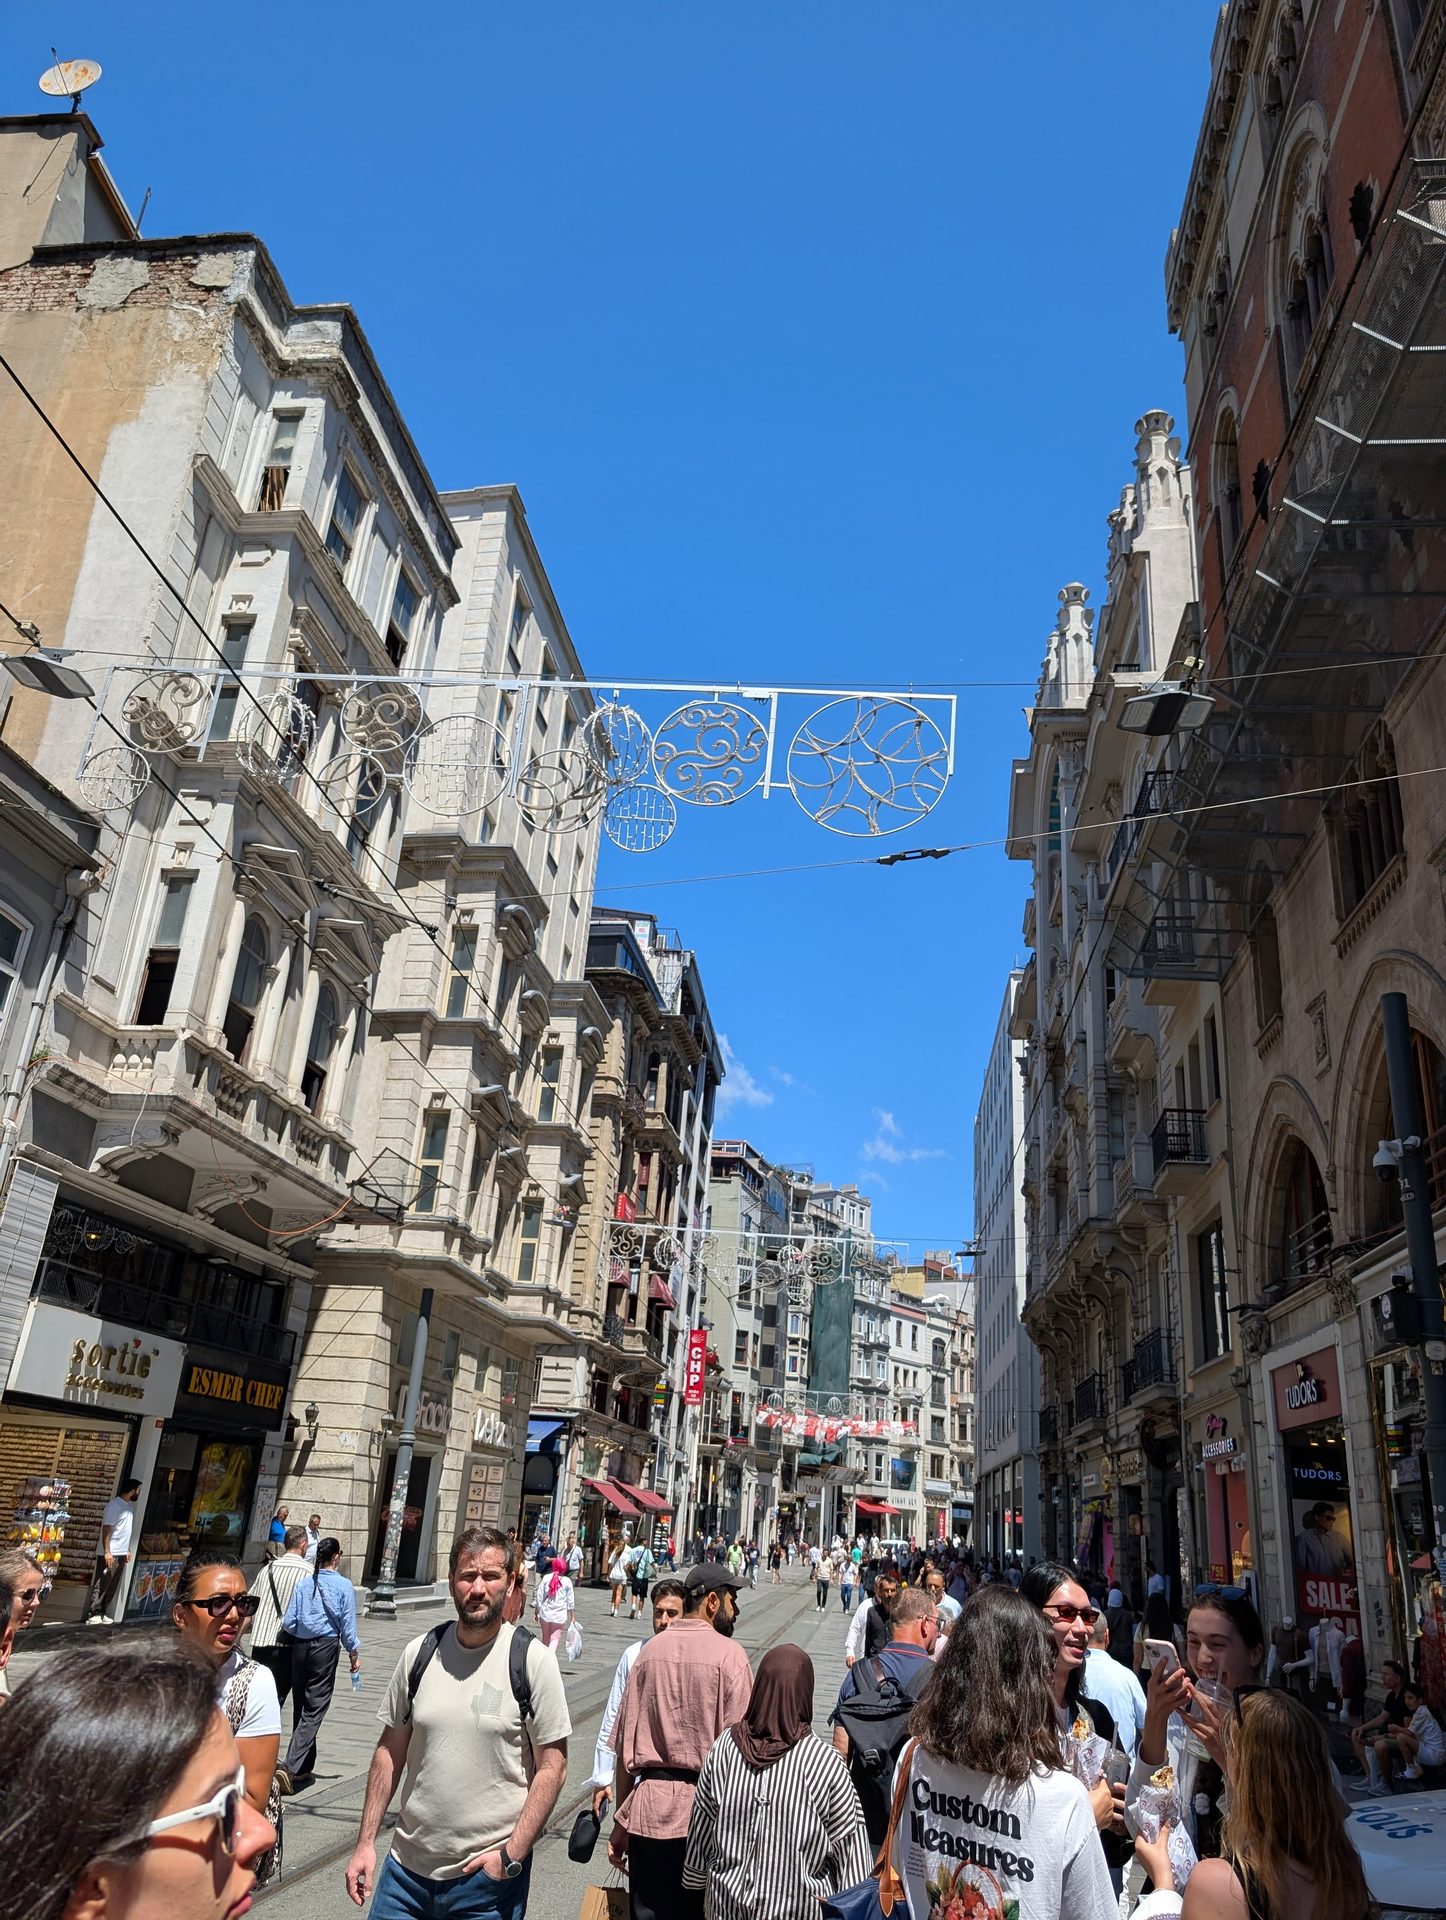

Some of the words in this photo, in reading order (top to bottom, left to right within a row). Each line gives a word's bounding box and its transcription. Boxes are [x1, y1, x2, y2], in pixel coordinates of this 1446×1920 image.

[71, 1338, 152, 1379] sortie
[689, 1347, 703, 1387] CHP
[187, 1366, 244, 1402] ESMER
[246, 1380, 284, 1409] CHEF
[1285, 1379, 1318, 1409] TUDORS
[1202, 1437, 1234, 1458] ACCESSORIES
[474, 1469, 484, 1478] +3
[1293, 1467, 1342, 1481] TUDORS
[471, 1487, 482, 1497] +2
[469, 1506, 479, 1515] +1
[1306, 1580, 1351, 1611] SALE
[911, 1778, 1022, 1840] Custom
[1352, 1805, 1435, 1839] POLİS
